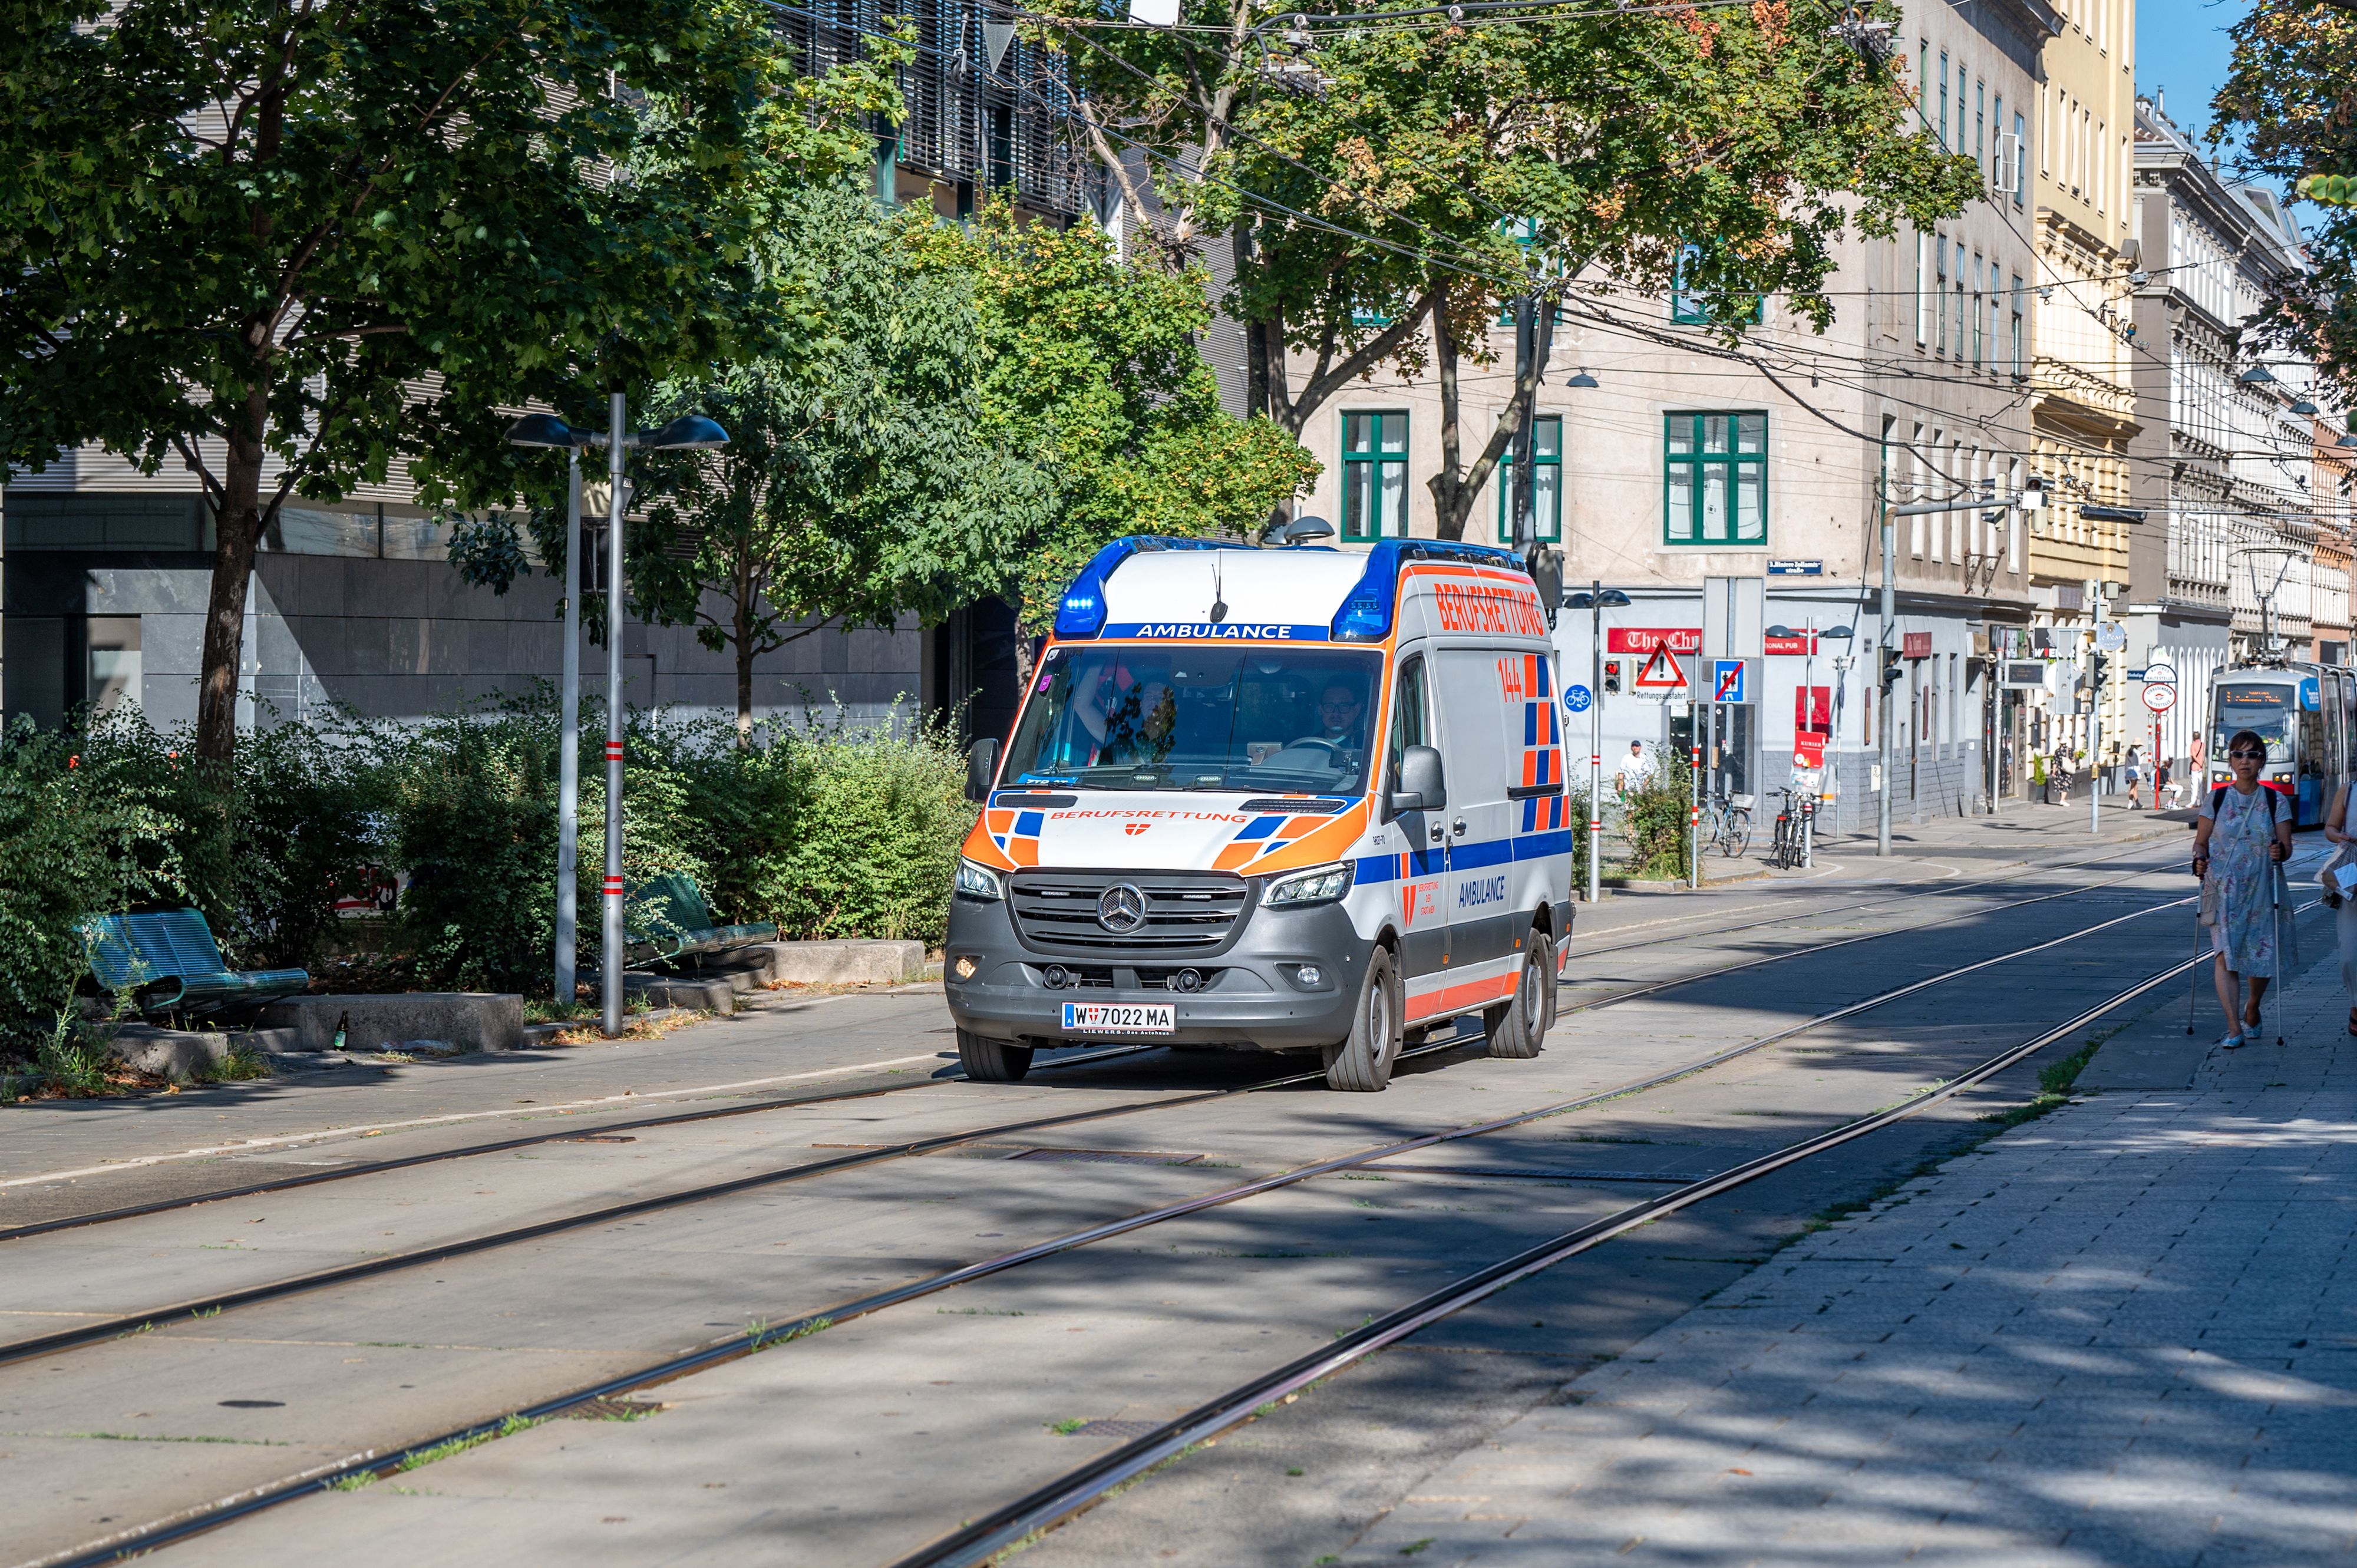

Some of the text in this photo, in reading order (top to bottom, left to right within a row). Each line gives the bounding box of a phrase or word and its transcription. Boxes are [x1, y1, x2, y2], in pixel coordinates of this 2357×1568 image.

[1434, 583, 1544, 636] BERUFSRETTUNG
[1136, 625, 1292, 639] AMBULANCE
[1627, 631, 1659, 651] The
[1498, 658, 1522, 702] 144
[1637, 691, 1686, 701] Rettungsausfahrt
[1050, 810, 1248, 823] BERUFSRETTUNG
[1458, 876, 1505, 908] AMBULANCE
[1075, 1008, 1169, 1026] W 7022 MA
